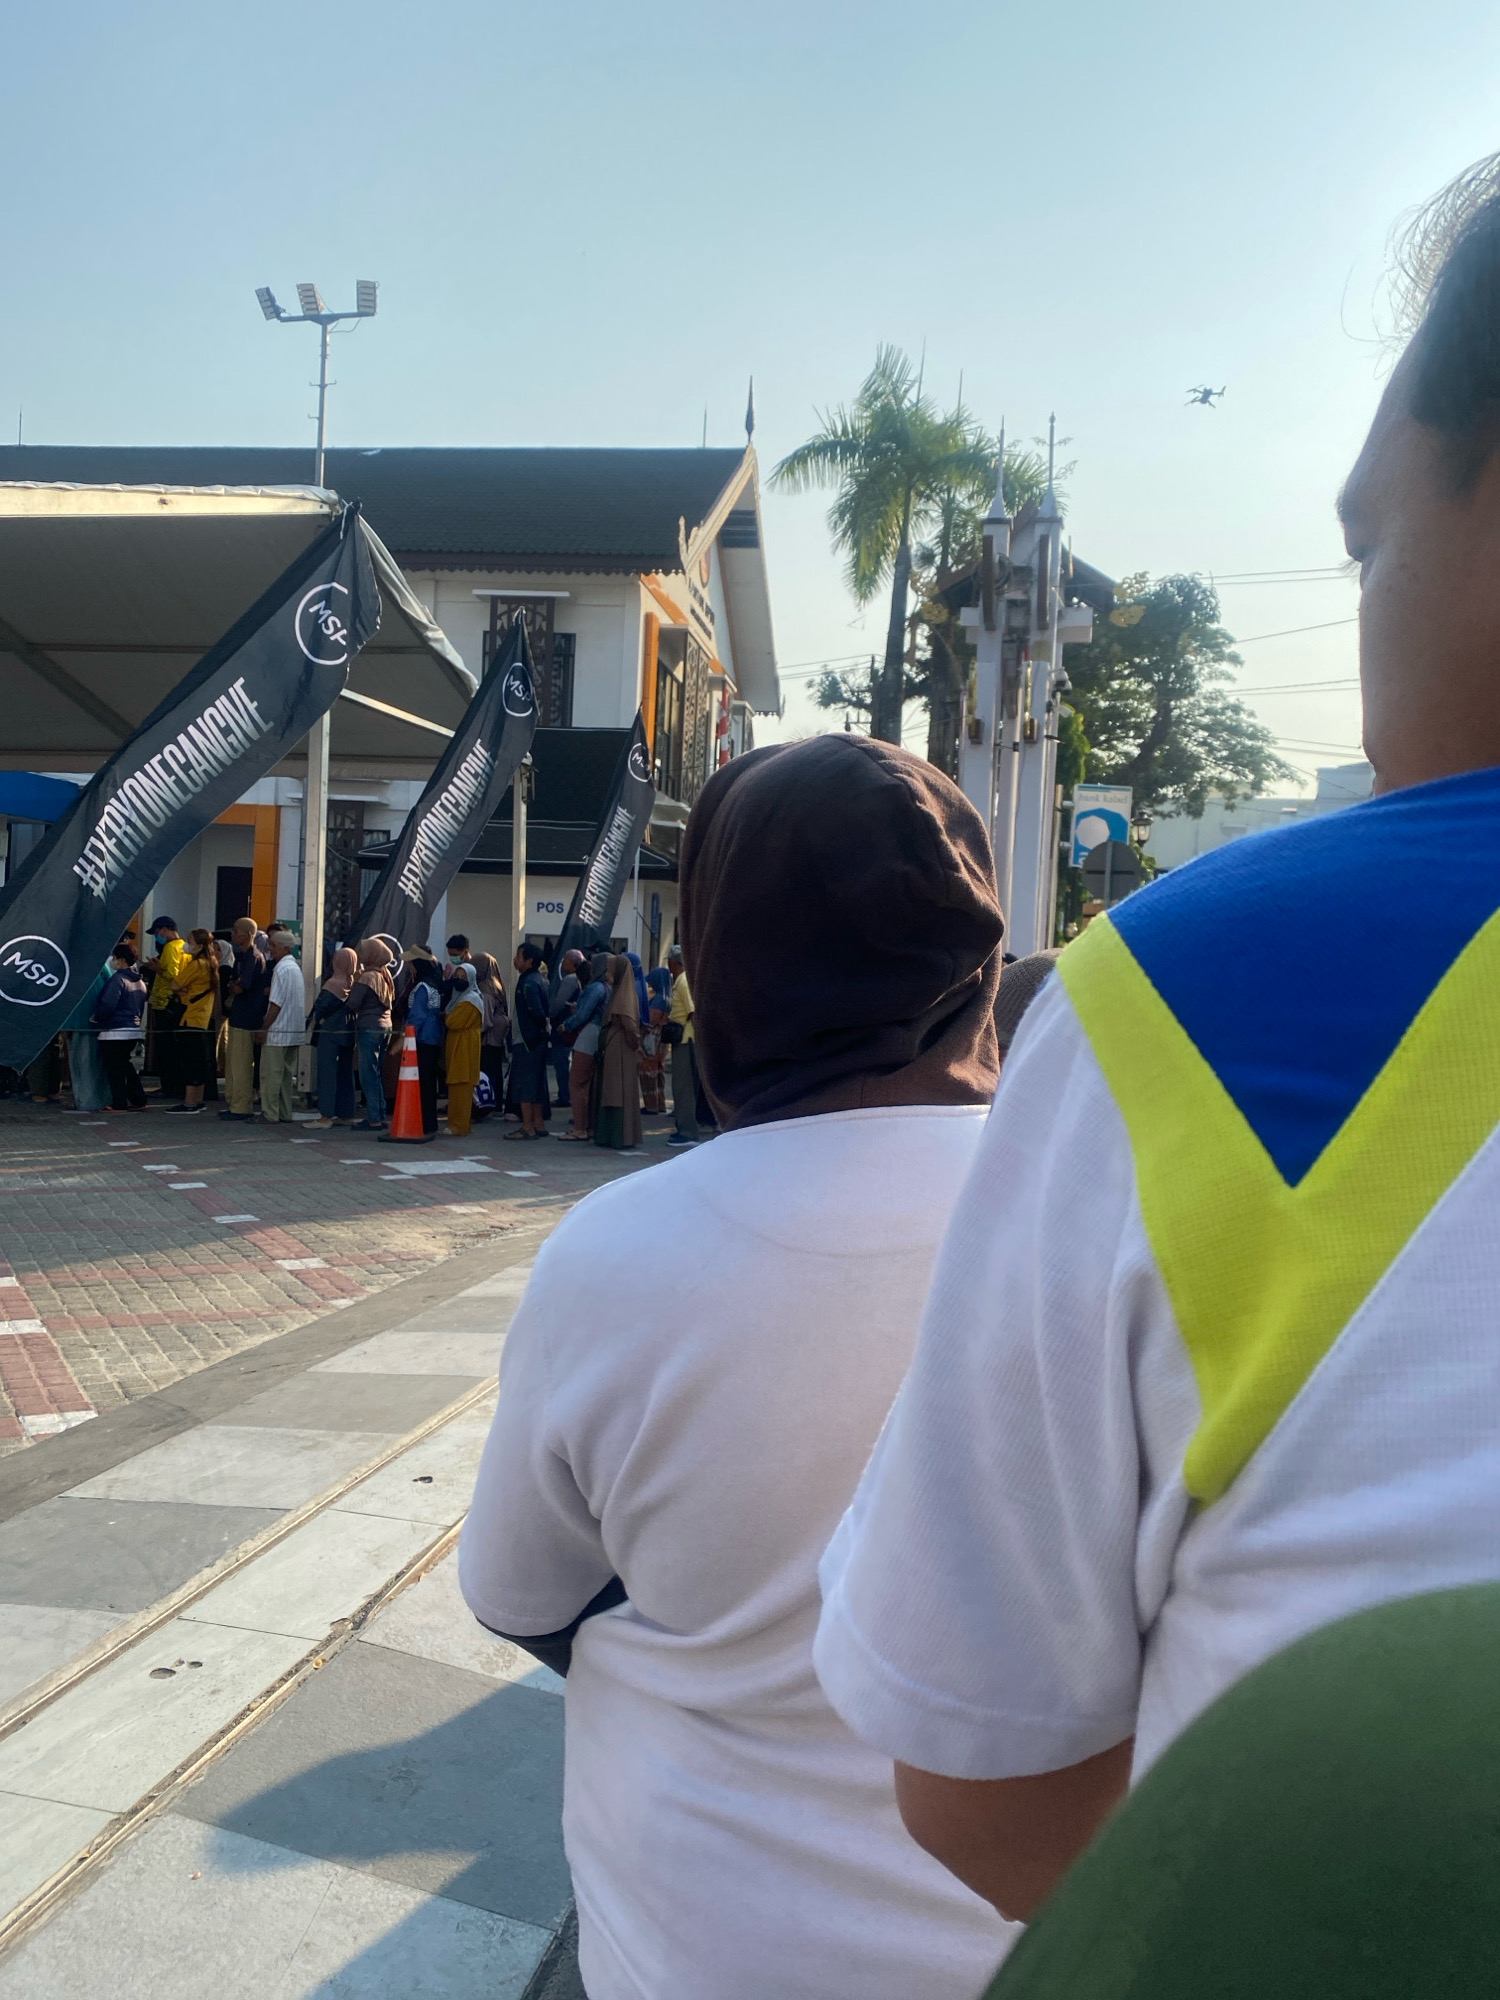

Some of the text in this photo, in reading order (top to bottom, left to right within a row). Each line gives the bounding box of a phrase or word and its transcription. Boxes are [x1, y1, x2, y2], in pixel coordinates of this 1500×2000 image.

[72, 677, 275, 904] #EVERYONECANGIVE
[397, 738, 500, 908] #EVERYONECANGIVE
[536, 901, 565, 914] POS
[2, 951, 60, 987] MSP
